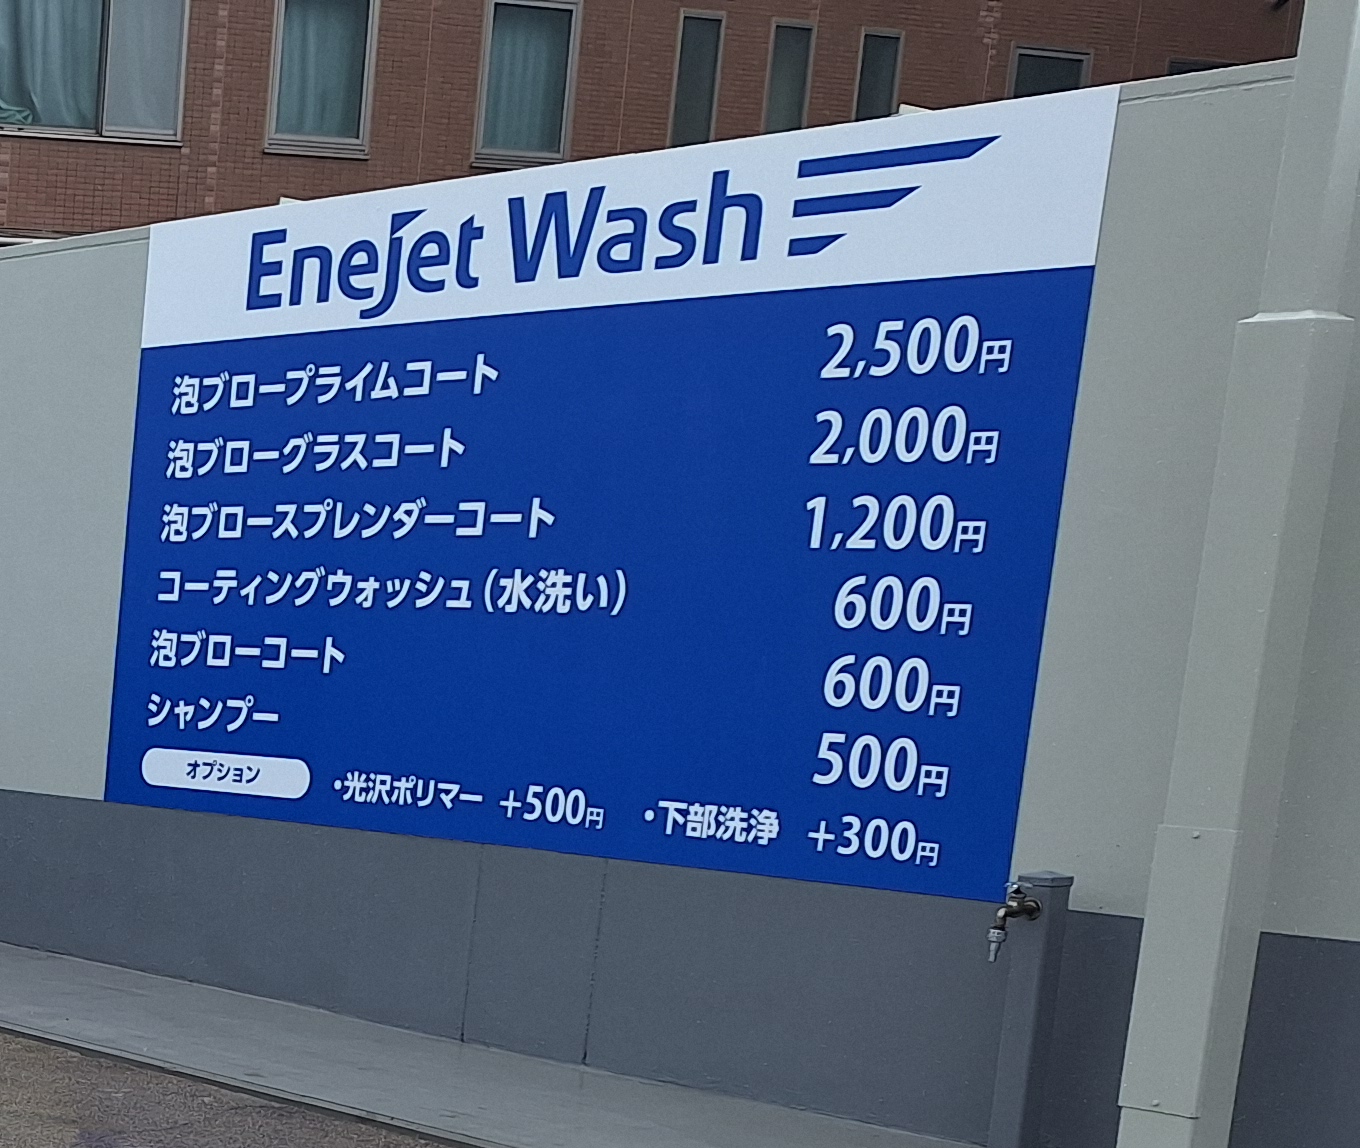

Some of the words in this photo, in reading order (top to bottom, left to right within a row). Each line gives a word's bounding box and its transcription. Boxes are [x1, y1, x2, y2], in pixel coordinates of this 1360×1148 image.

[507, 169, 763, 283] Wash
[170, 352, 499, 415] 泡ブロープライムコート
[820, 316, 1012, 379] 2,500円
[166, 428, 465, 478] 泡ブローグラスコート
[810, 406, 999, 464] 2,000円
[161, 497, 555, 541] 泡ブロースプレンダーコート
[806, 495, 986, 552] 1,200円
[834, 576, 972, 635] 600円
[150, 630, 345, 673] 泡ブローコート
[823, 655, 960, 716] 600円
[147, 694, 279, 731] シャンプー
[813, 733, 949, 798] 500円
[185, 760, 262, 784] オプション
[499, 784, 604, 829] +500円
[808, 815, 940, 867] +300円
